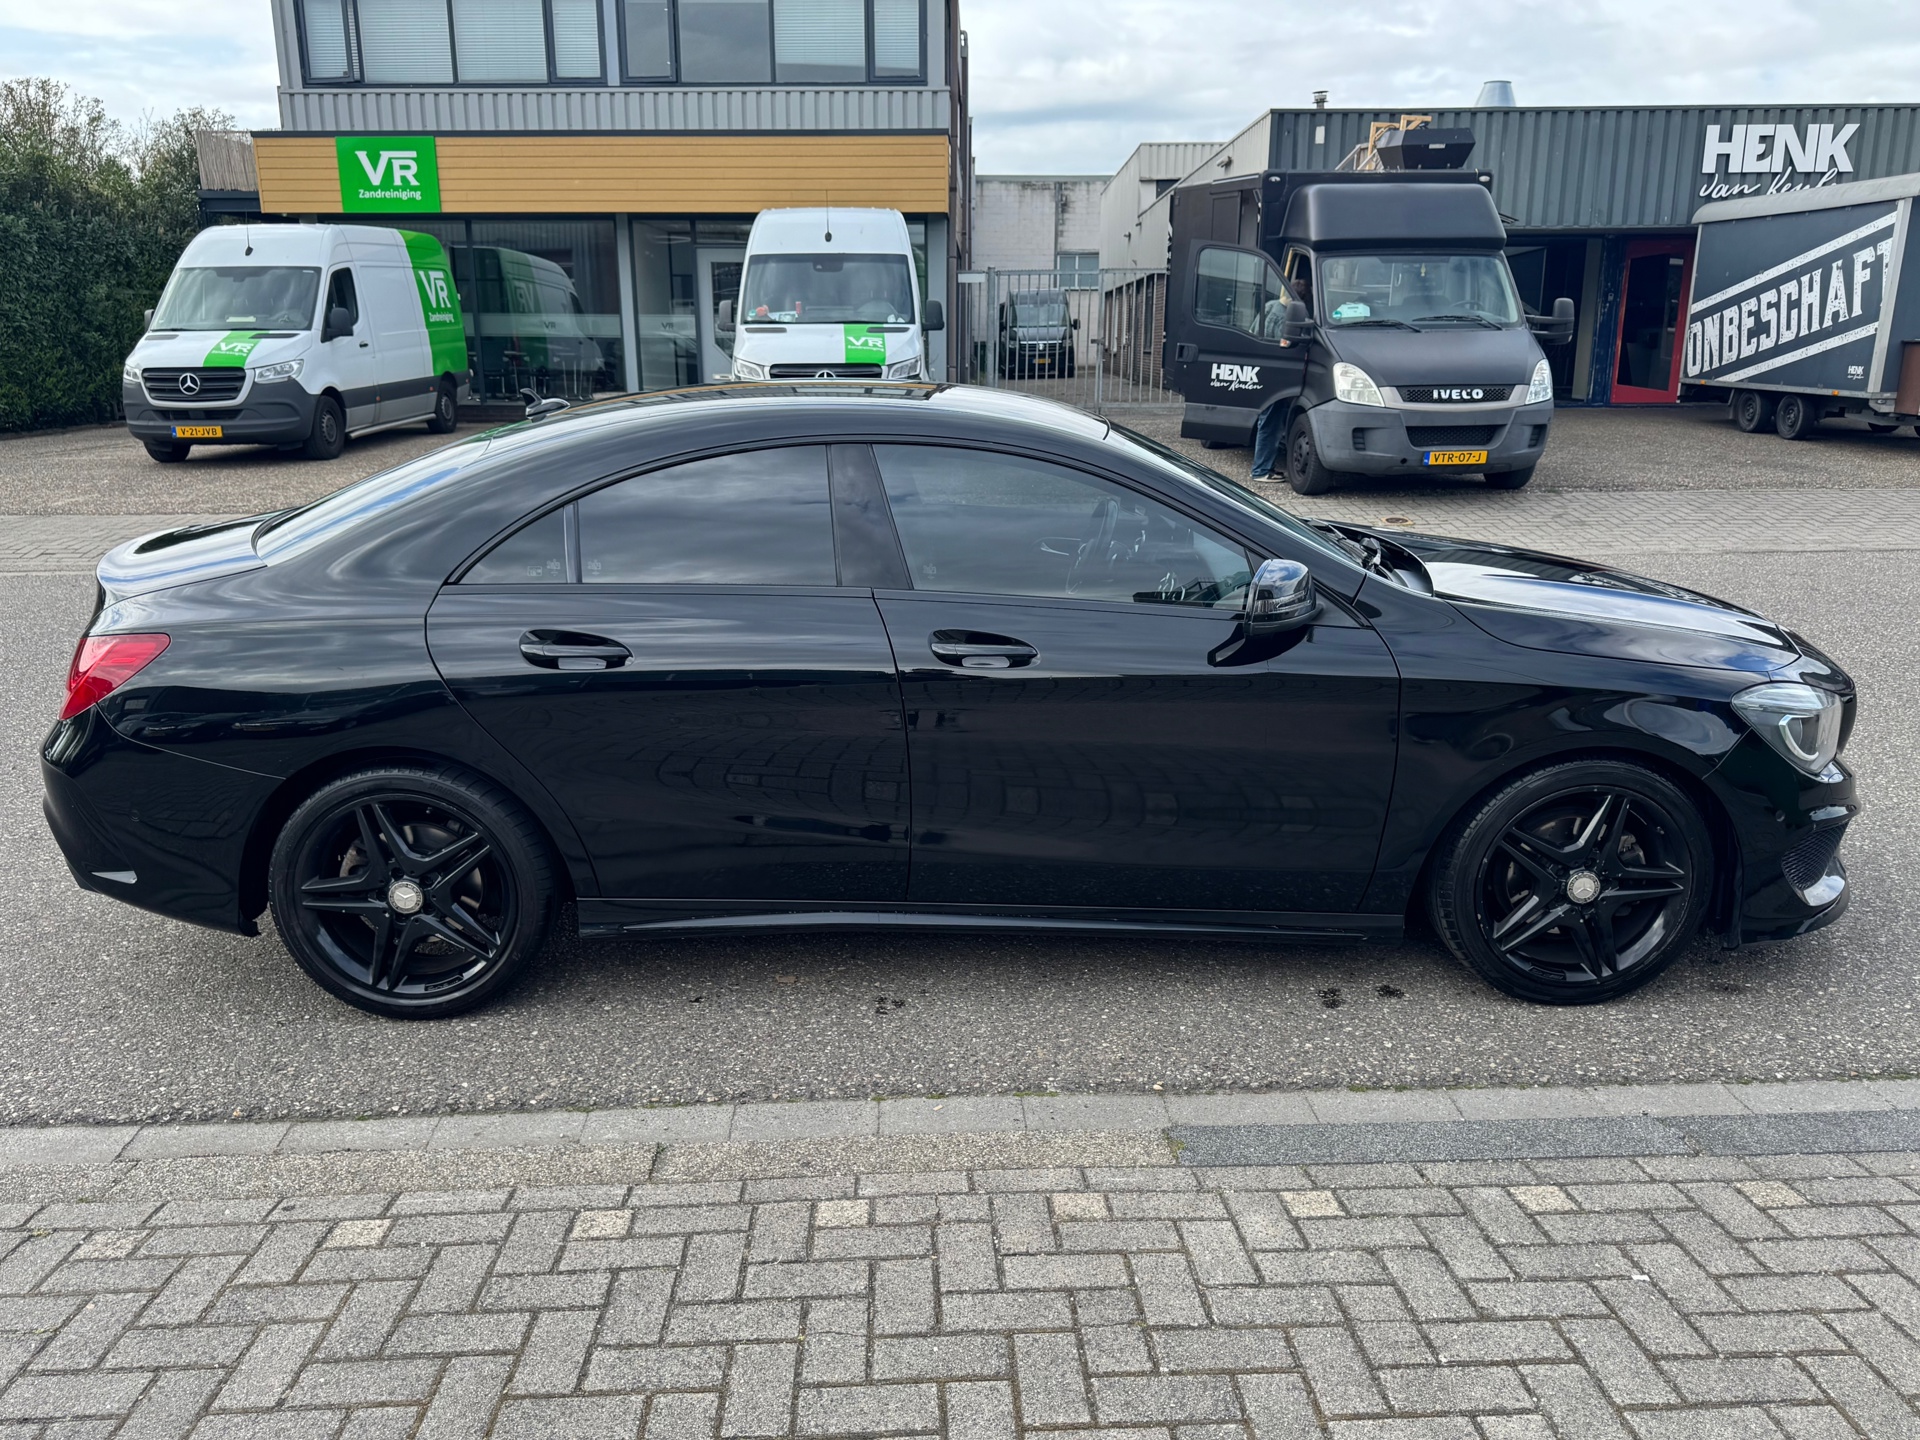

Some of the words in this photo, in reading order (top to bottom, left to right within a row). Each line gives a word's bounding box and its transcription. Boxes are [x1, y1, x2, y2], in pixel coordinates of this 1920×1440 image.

[1702, 124, 1860, 173] HENK
[354, 150, 420, 186] VR
[1699, 173, 1761, 199] van
[358, 188, 422, 201] Zandreiniging
[418, 270, 452, 309] VR
[220, 342, 254, 353] VR
[846, 336, 884, 348] VR
[1211, 363, 1261, 383] HENK
[1433, 388, 1484, 400] IVECO
[180, 427, 218, 436] V-21-JVB
[1434, 452, 1482, 463] VTR-07-J
